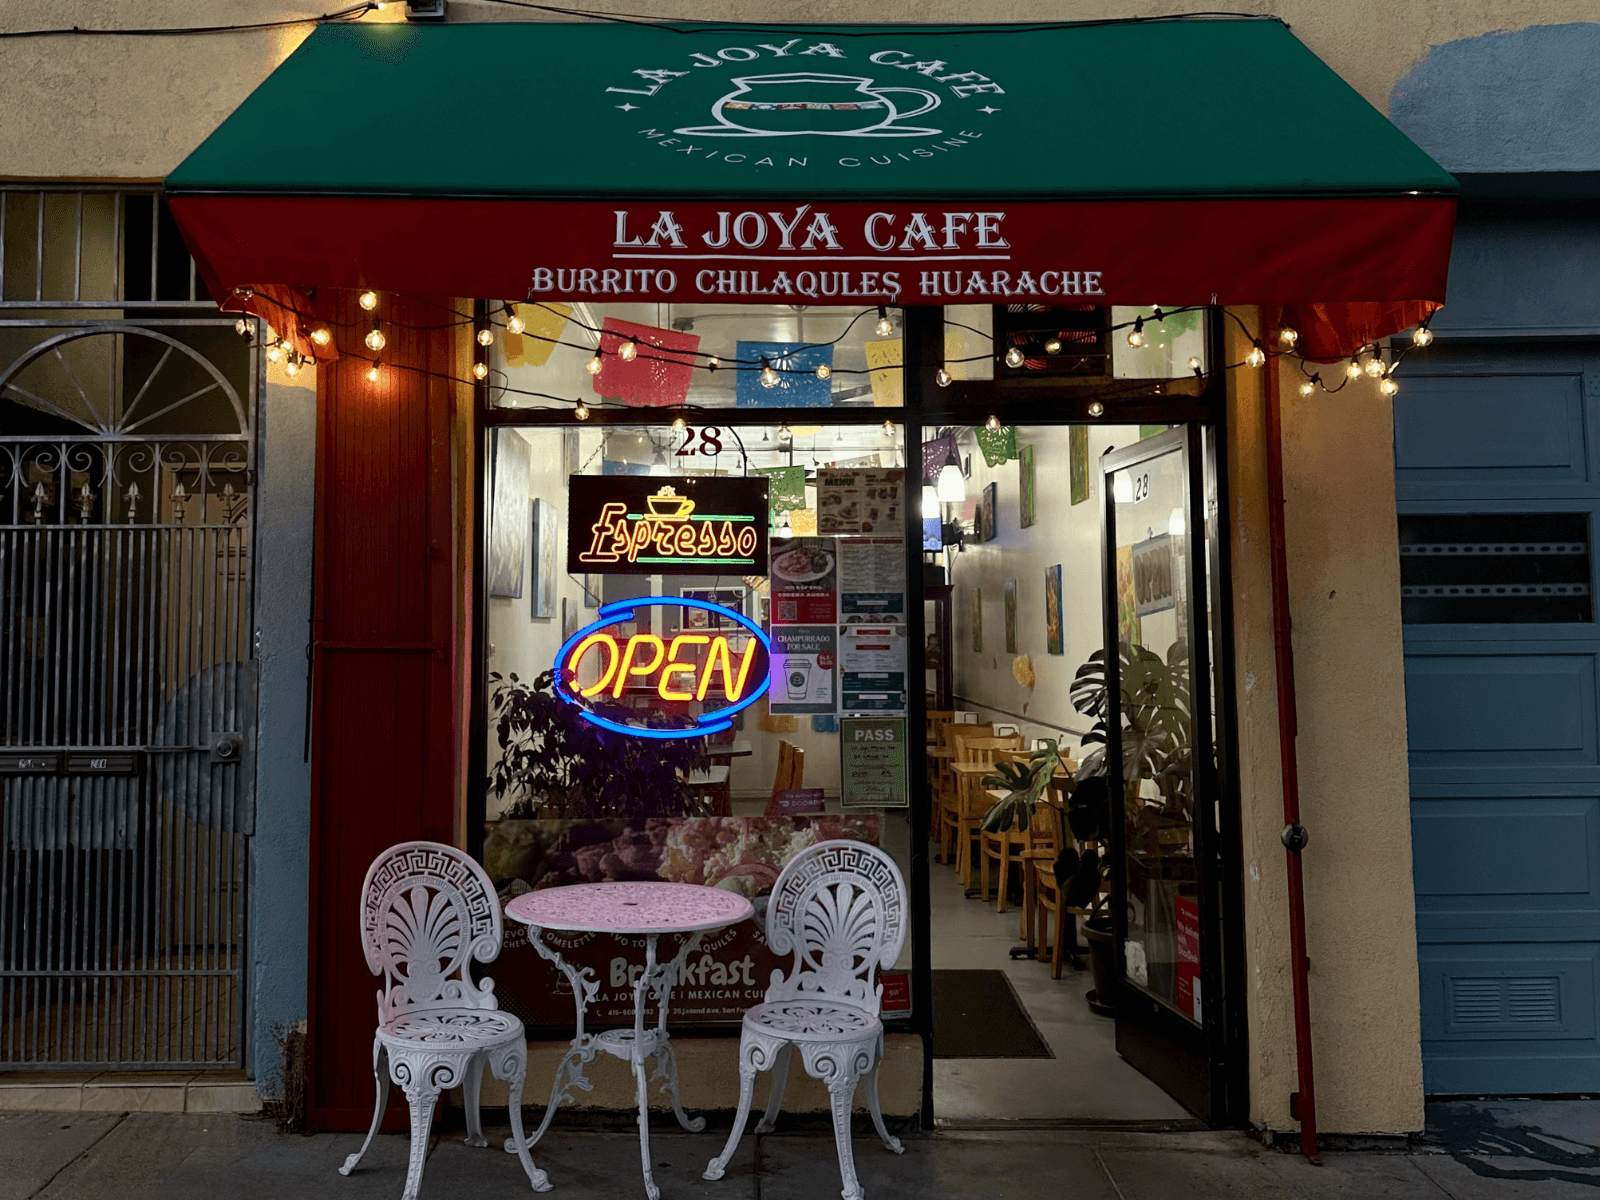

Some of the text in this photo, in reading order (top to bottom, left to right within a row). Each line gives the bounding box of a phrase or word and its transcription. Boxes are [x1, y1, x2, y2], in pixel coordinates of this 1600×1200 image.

[605, 38, 1006, 100] LA JOYA CAFE
[638, 128, 982, 167] MEXICAN CUISINE
[613, 204, 1011, 252] LA JOYA CAFE
[532, 267, 1106, 298] BURRITO CHILAQULES HUARACHE
[675, 426, 723, 456] 28
[1136, 474, 1148, 500] 28
[579, 503, 757, 562] Espresso
[777, 635, 831, 643] CHAMPURRADO
[787, 643, 821, 651] FOR SALE
[568, 634, 757, 702] OPEN
[855, 729, 895, 741] PASS
[546, 930, 597, 948] OMELETTE
[610, 954, 756, 988] Brkfast
[614, 992, 635, 1002] JOY
[688, 990, 740, 1000] MEXICAN
